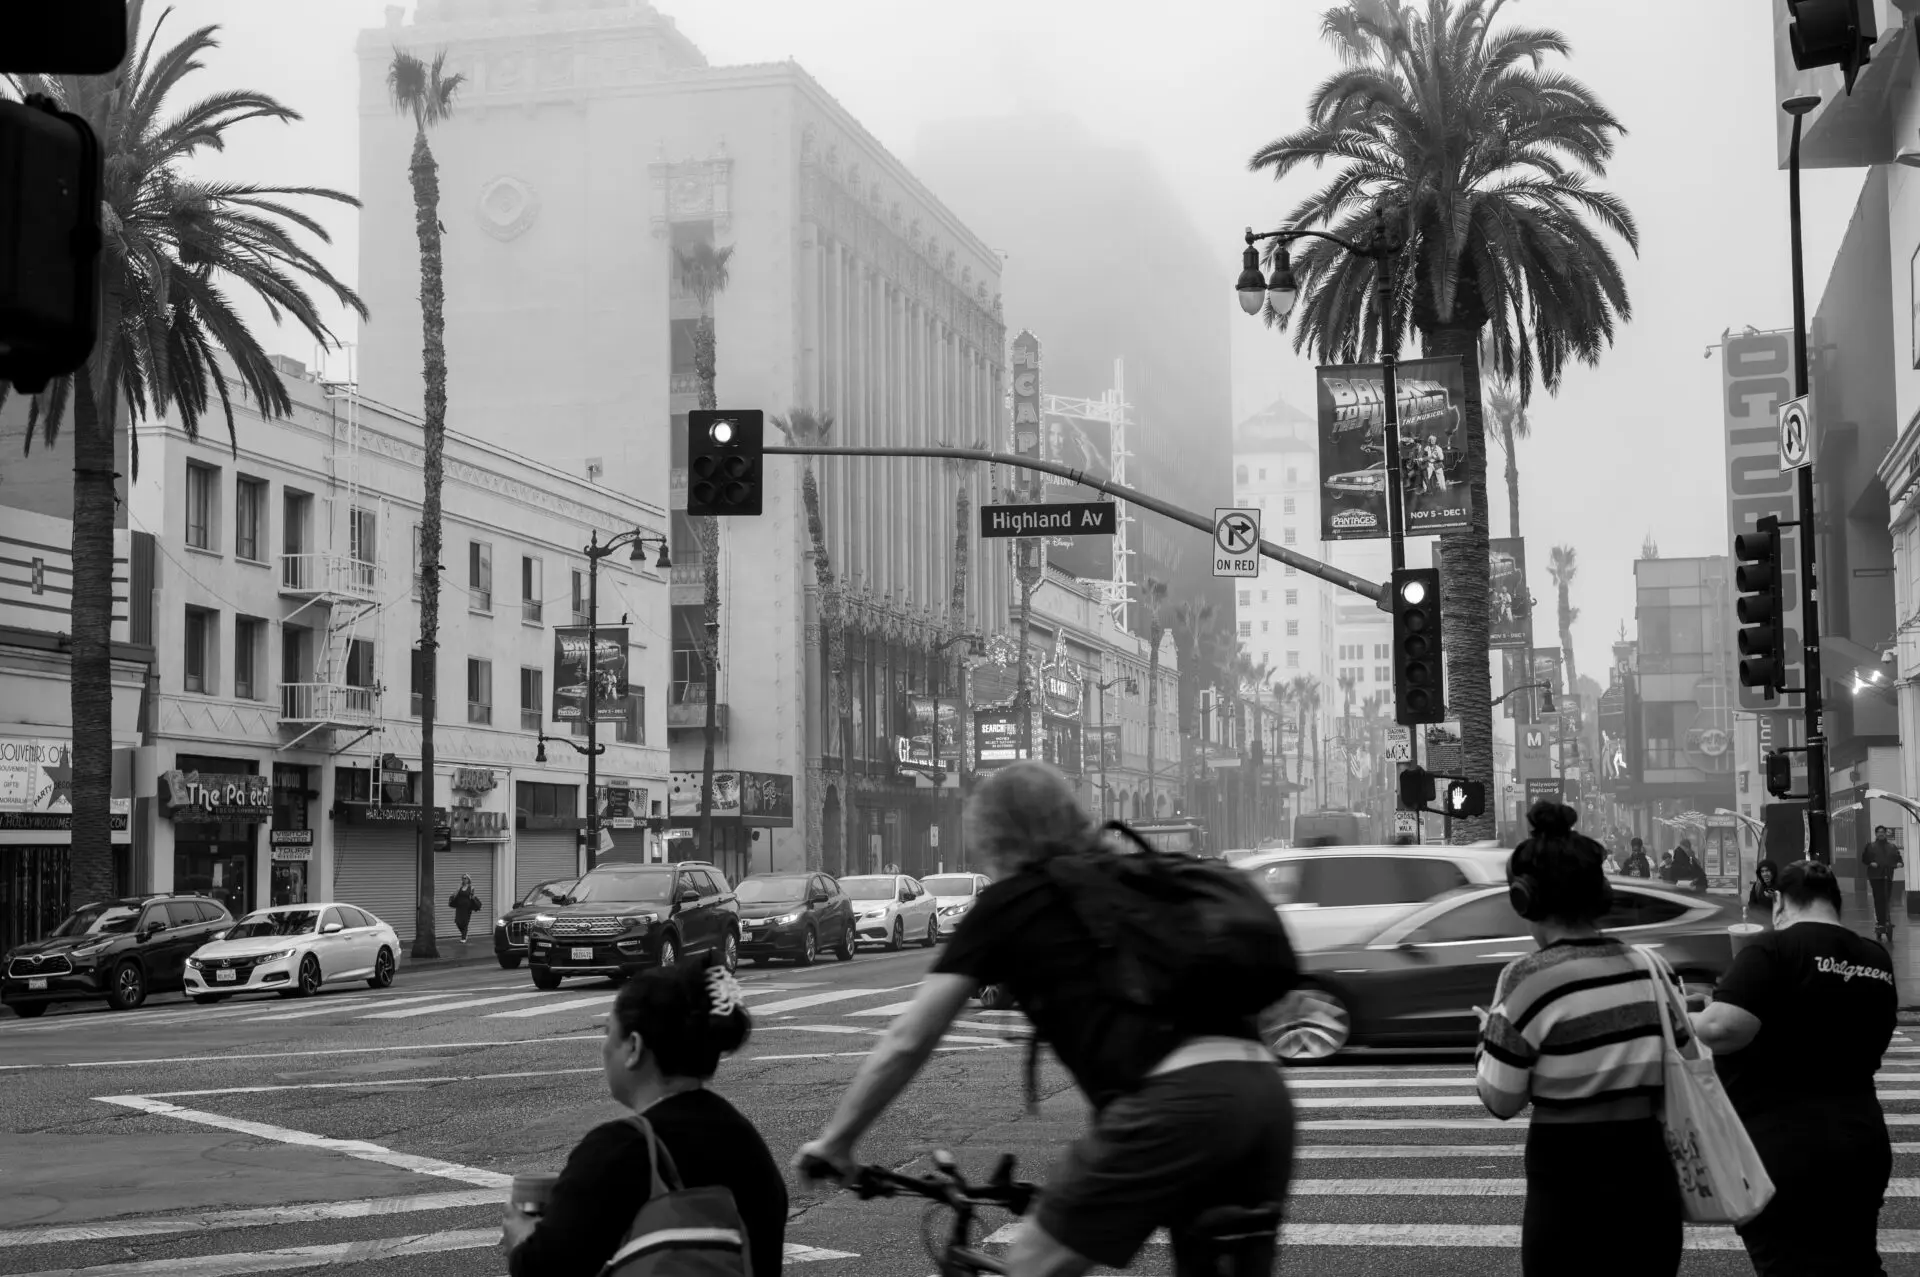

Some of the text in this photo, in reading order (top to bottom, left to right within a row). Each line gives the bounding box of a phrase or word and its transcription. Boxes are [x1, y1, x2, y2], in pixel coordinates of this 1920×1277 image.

[1416, 410, 1444, 422] MUSICAL
[1333, 515, 1376, 525] PANTAGES
[1410, 510, 1430, 519] NOV
[1430, 509, 1436, 518] 5
[1443, 508, 1461, 518] DEC
[1462, 507, 1467, 516] 1
[992, 508, 1103, 534] Highland Av
[1216, 559, 1256, 572] ON RED
[1527, 732, 1542, 747] M
[33, 783, 53, 807] PARTY
[186, 782, 220, 812] The
